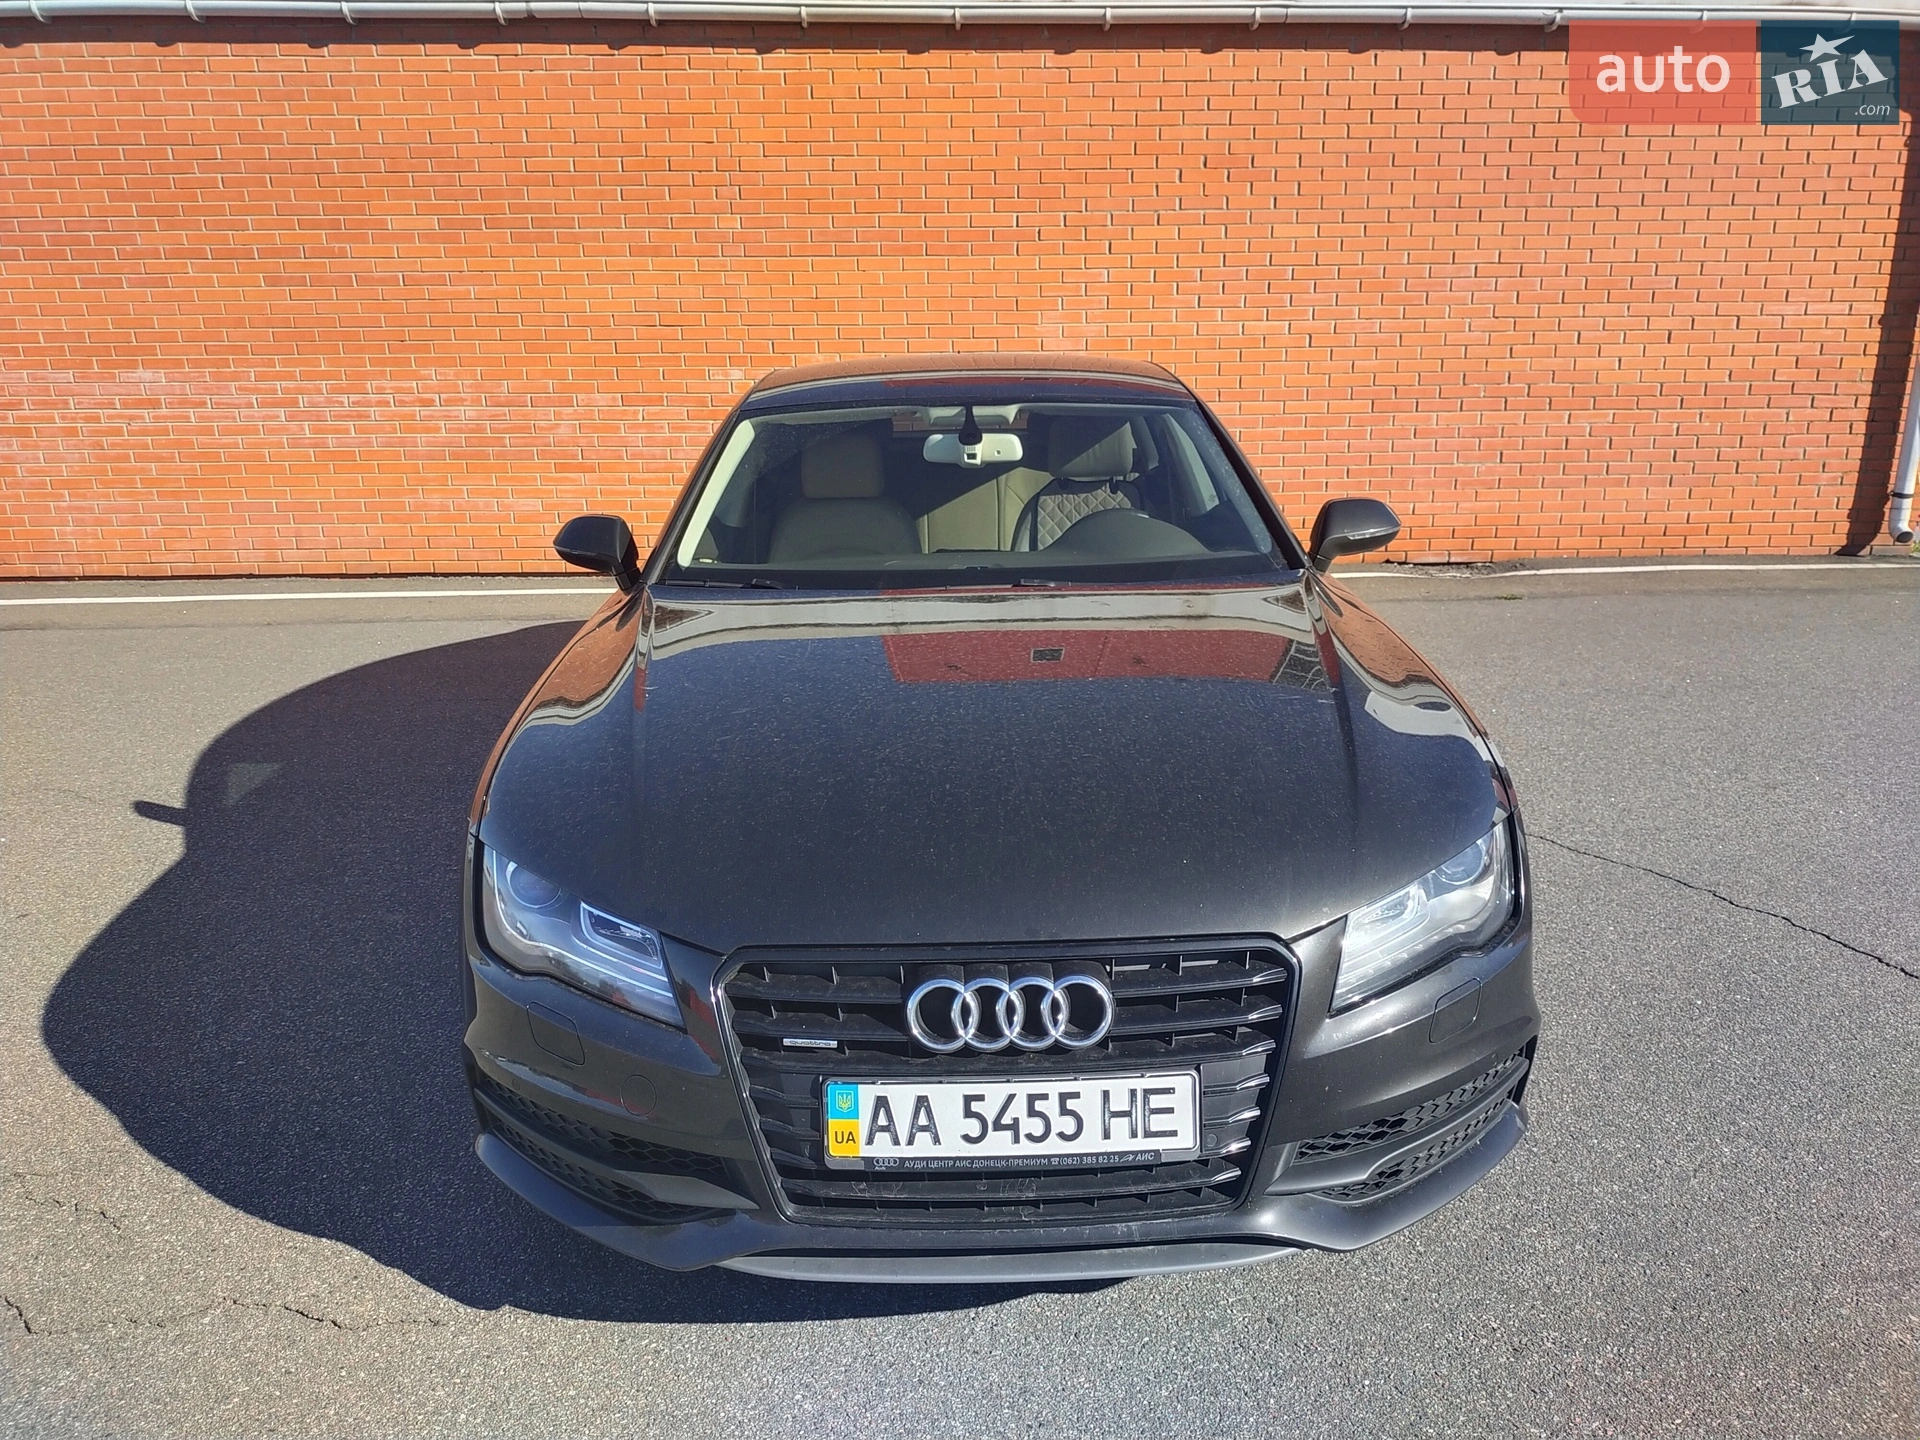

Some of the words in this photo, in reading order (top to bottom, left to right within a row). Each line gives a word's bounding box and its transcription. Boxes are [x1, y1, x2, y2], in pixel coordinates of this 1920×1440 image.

[865, 1093, 942, 1147] AA
[959, 1091, 1085, 1146] 5455
[1100, 1087, 1179, 1141] HE
[834, 1131, 856, 1145] UA
[904, 1160, 926, 1169] АУДИ
[928, 1159, 953, 1168] ЦЕНТР
[955, 1159, 971, 1168] АИС
[973, 1157, 1048, 1168] ДОНЕЦК-ПРЕМИУМ
[1060, 1156, 1080, 1165] (062)
[1082, 1155, 1096, 1164] 385
[1098, 1155, 1108, 1163] 82
[1109, 1154, 1119, 1163] 25
[1135, 1152, 1155, 1161] АИС
